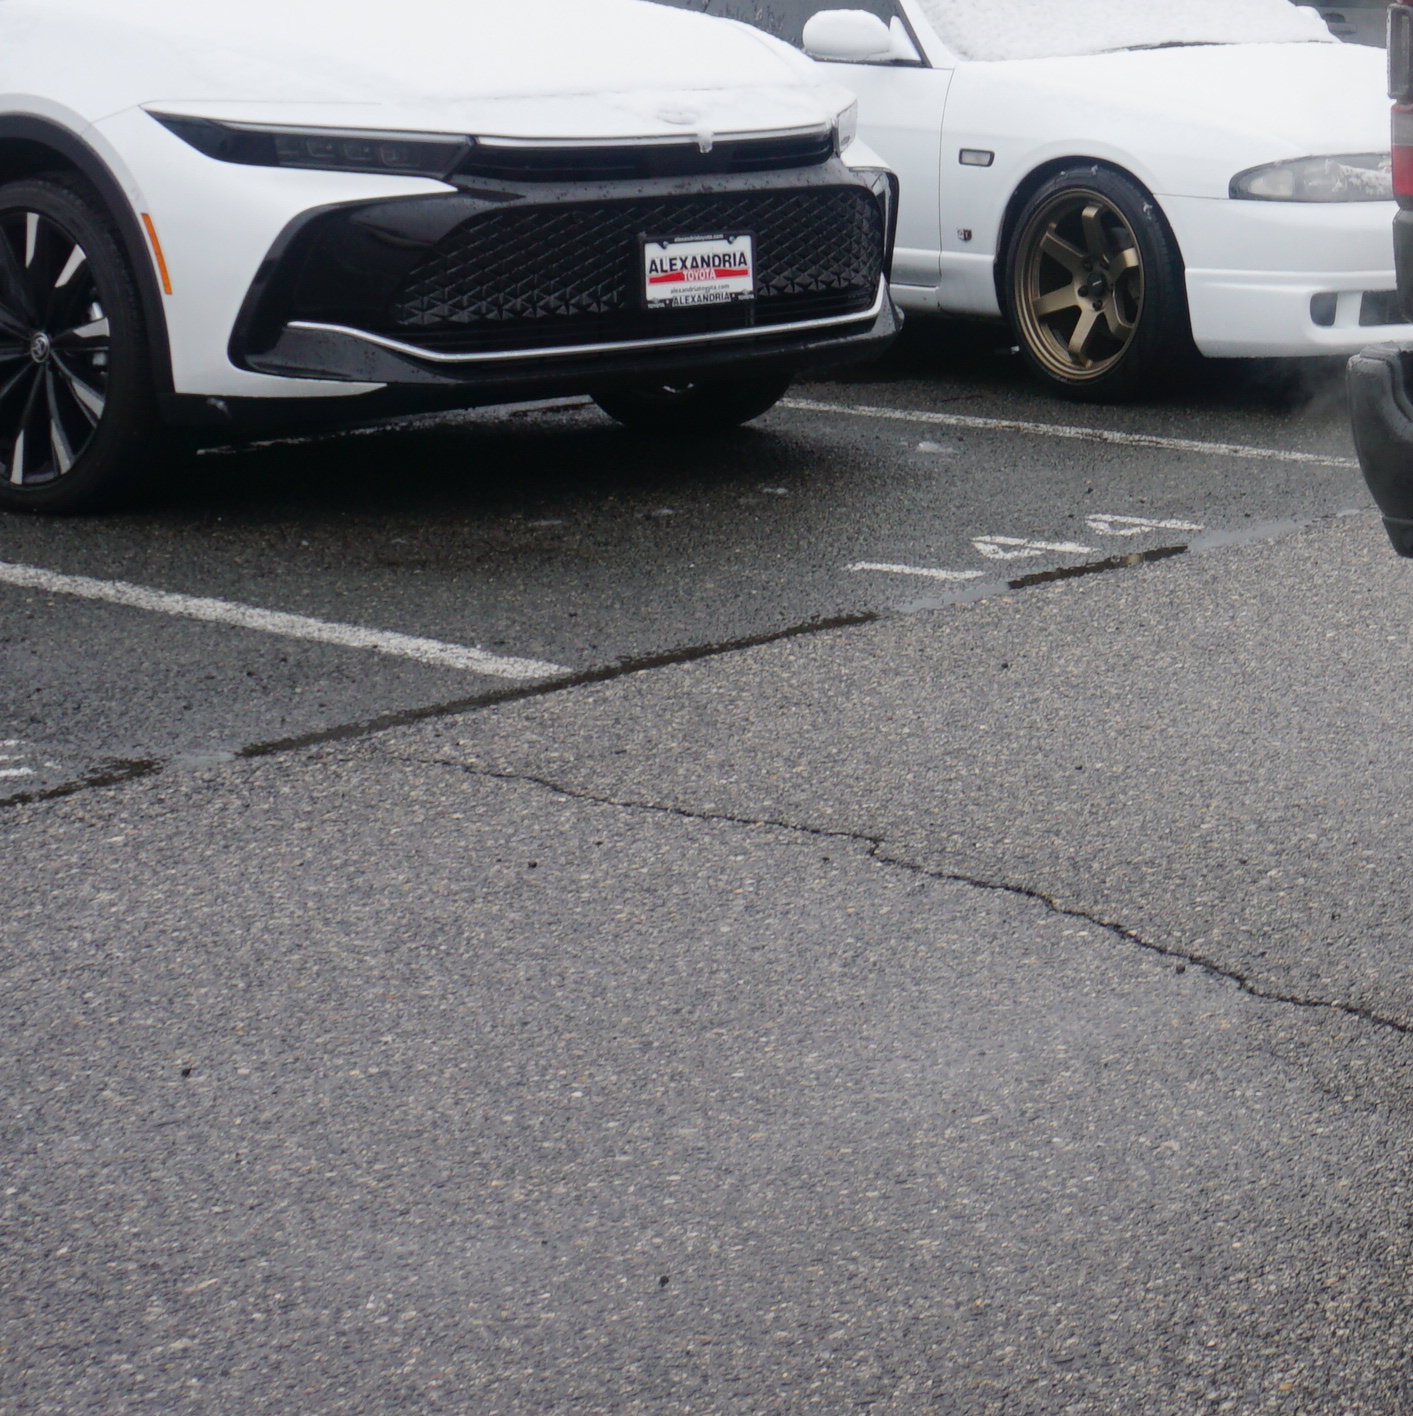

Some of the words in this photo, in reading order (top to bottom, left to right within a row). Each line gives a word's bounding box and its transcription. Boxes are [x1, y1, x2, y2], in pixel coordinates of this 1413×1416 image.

[649, 252, 748, 274] ALEXANDRIA
[683, 268, 717, 282] TOYOTA
[672, 291, 731, 305] ALEXANDRIA
